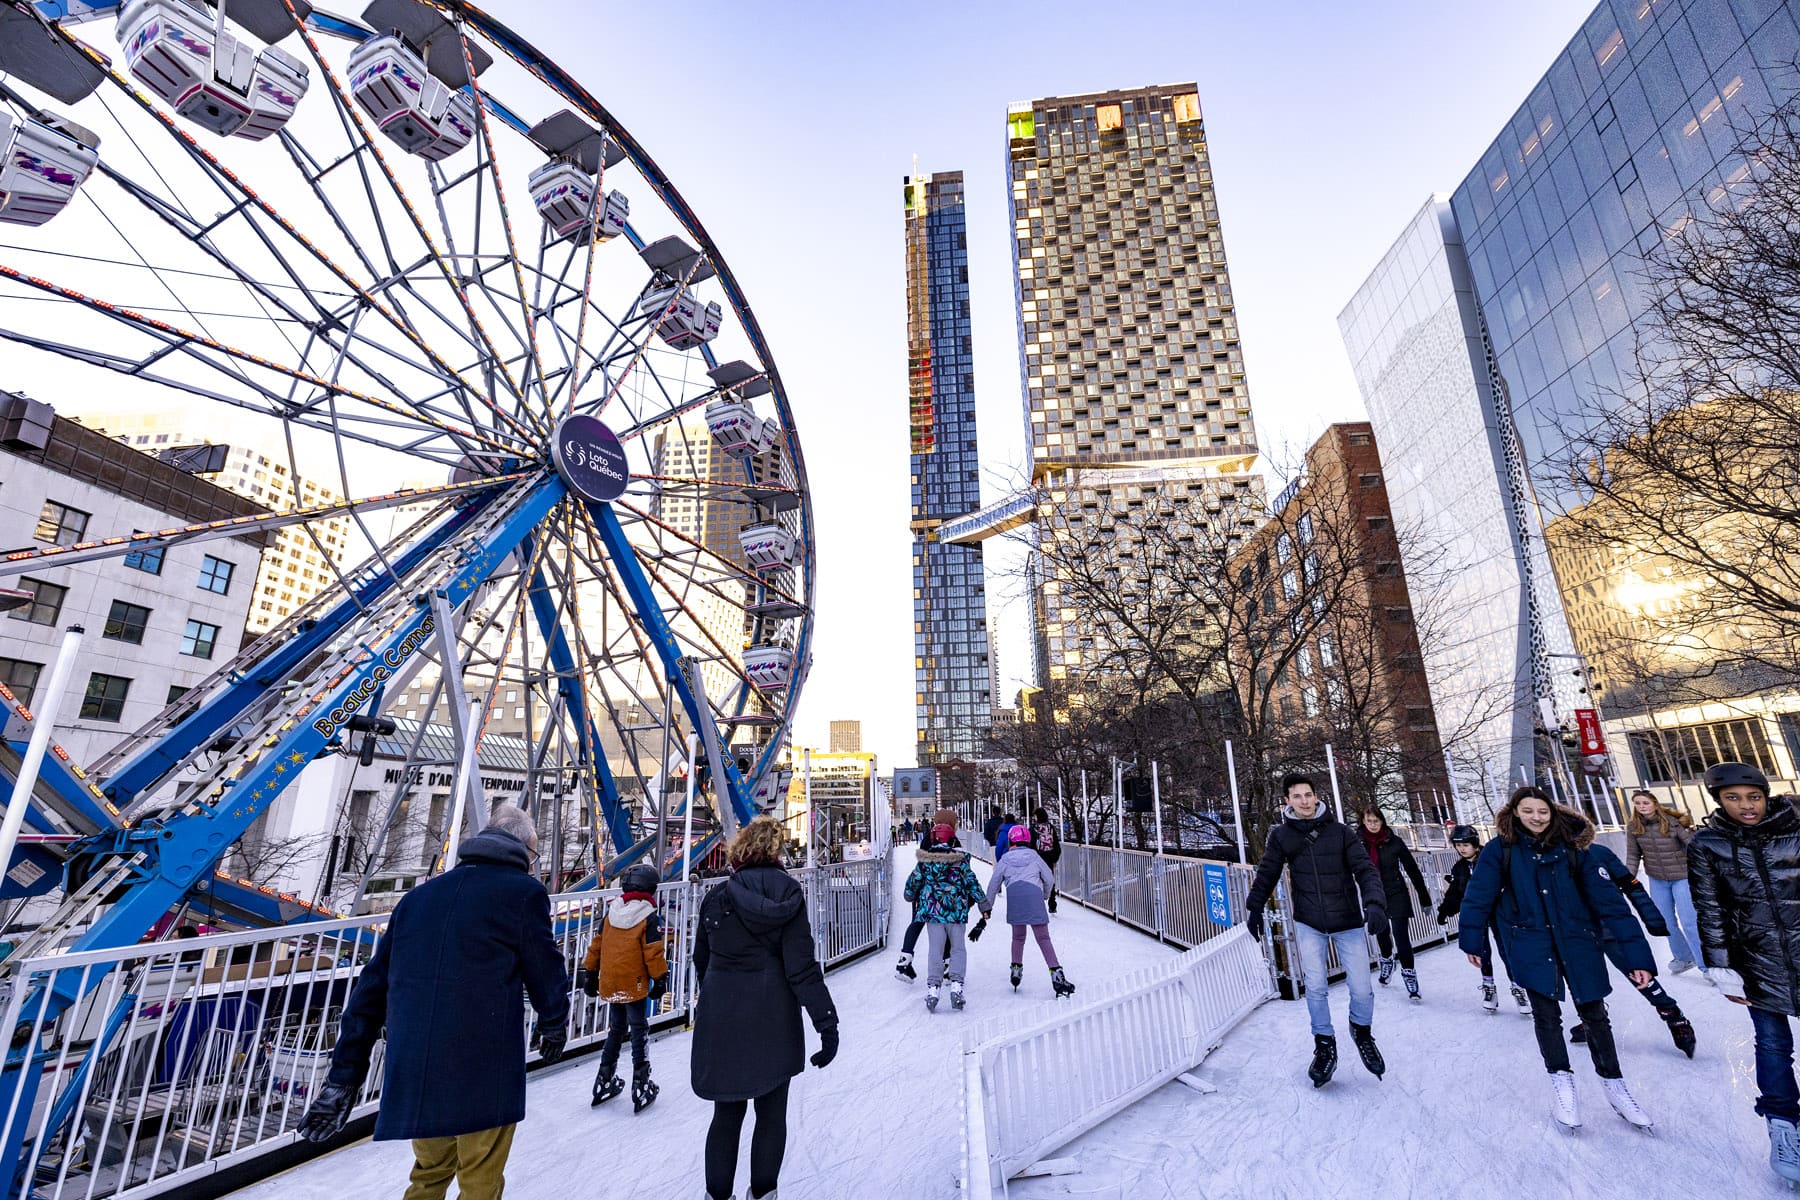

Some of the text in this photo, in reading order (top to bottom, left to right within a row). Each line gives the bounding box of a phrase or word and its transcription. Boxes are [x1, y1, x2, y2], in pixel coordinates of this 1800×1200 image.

[589, 451, 608, 466] Loto
[589, 460, 623, 481] Québec
[314, 603, 453, 738] Beauce Carna
[428, 772, 453, 787] D'AR
[481, 777, 526, 791] TEMPORAIN
